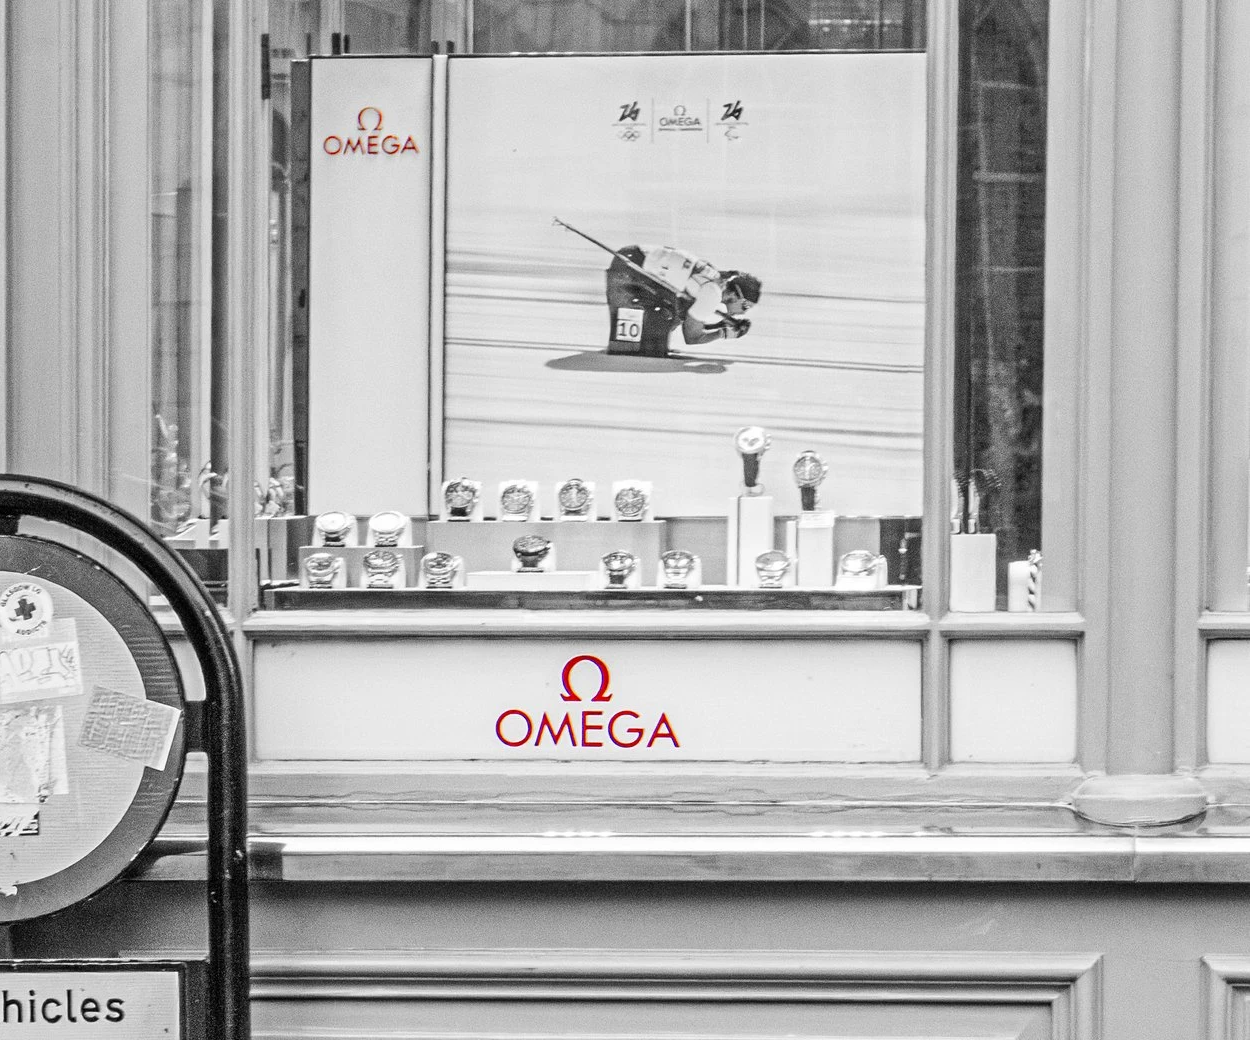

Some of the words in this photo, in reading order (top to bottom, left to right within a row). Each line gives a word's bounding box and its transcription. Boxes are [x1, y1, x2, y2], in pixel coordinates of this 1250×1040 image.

[659, 117, 702, 127] OMEGA
[323, 135, 420, 155] OMEGA
[618, 322, 640, 338] 10
[496, 709, 680, 748] OMEGA
